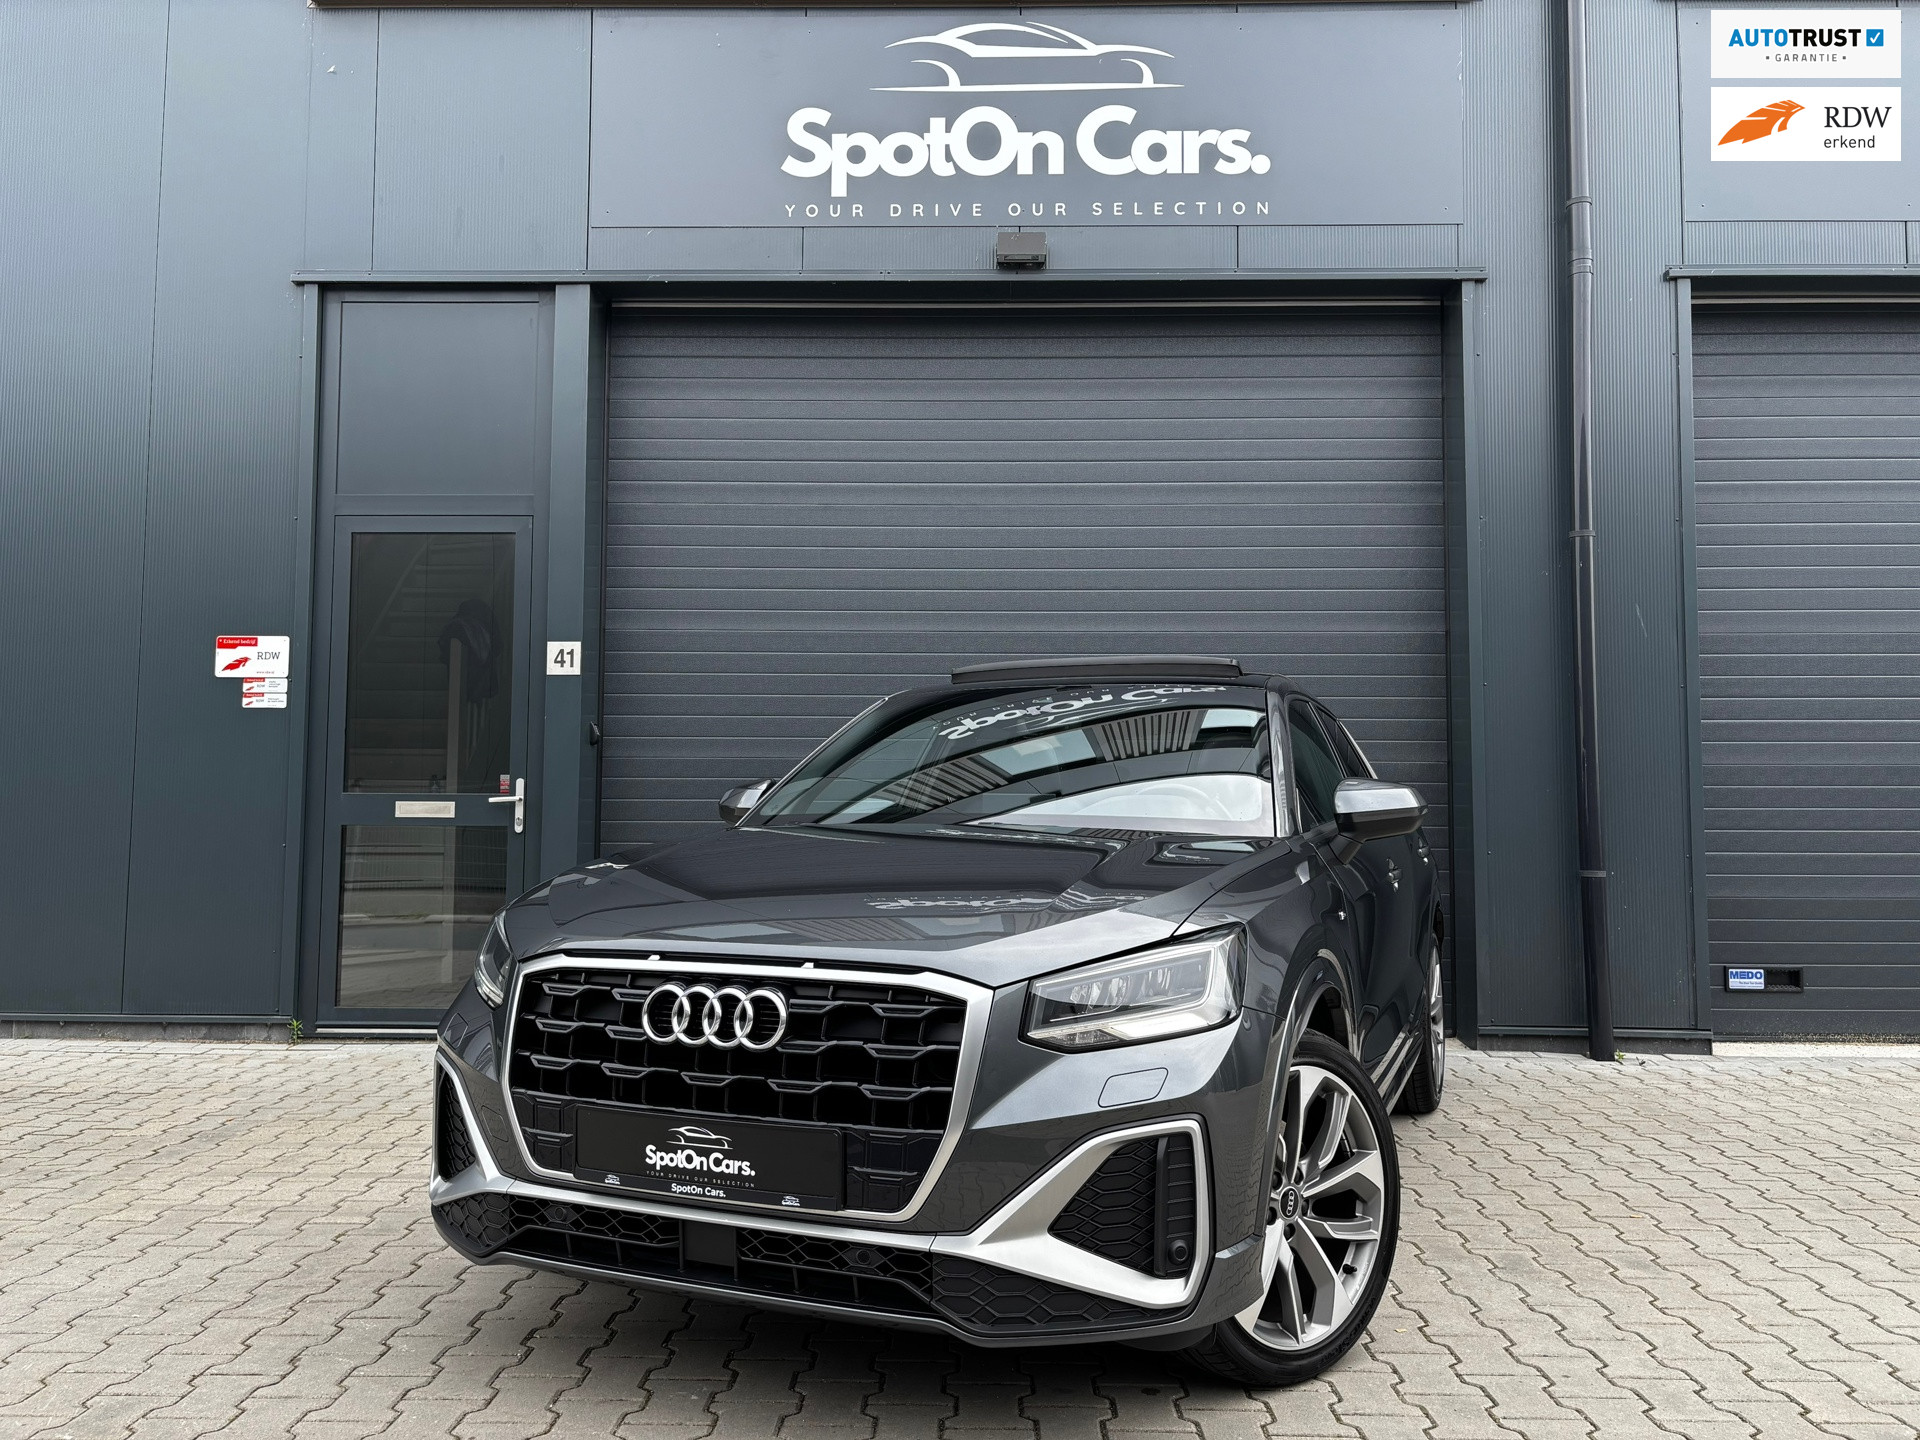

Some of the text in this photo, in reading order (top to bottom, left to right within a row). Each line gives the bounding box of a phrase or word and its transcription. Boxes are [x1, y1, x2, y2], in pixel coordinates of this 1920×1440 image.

[780, 104, 1271, 198] SpotOn Cars.
[785, 201, 1270, 218] YOUR DRIVE OUR SELECTION
[257, 651, 281, 660] RDW
[554, 648, 575, 668] 41
[1730, 971, 1763, 979] MEDO
[645, 1144, 756, 1176] SpotOn Cars.
[671, 1183, 726, 1198] SpotOn Cars.
[713, 1178, 754, 1188] SELECTION
